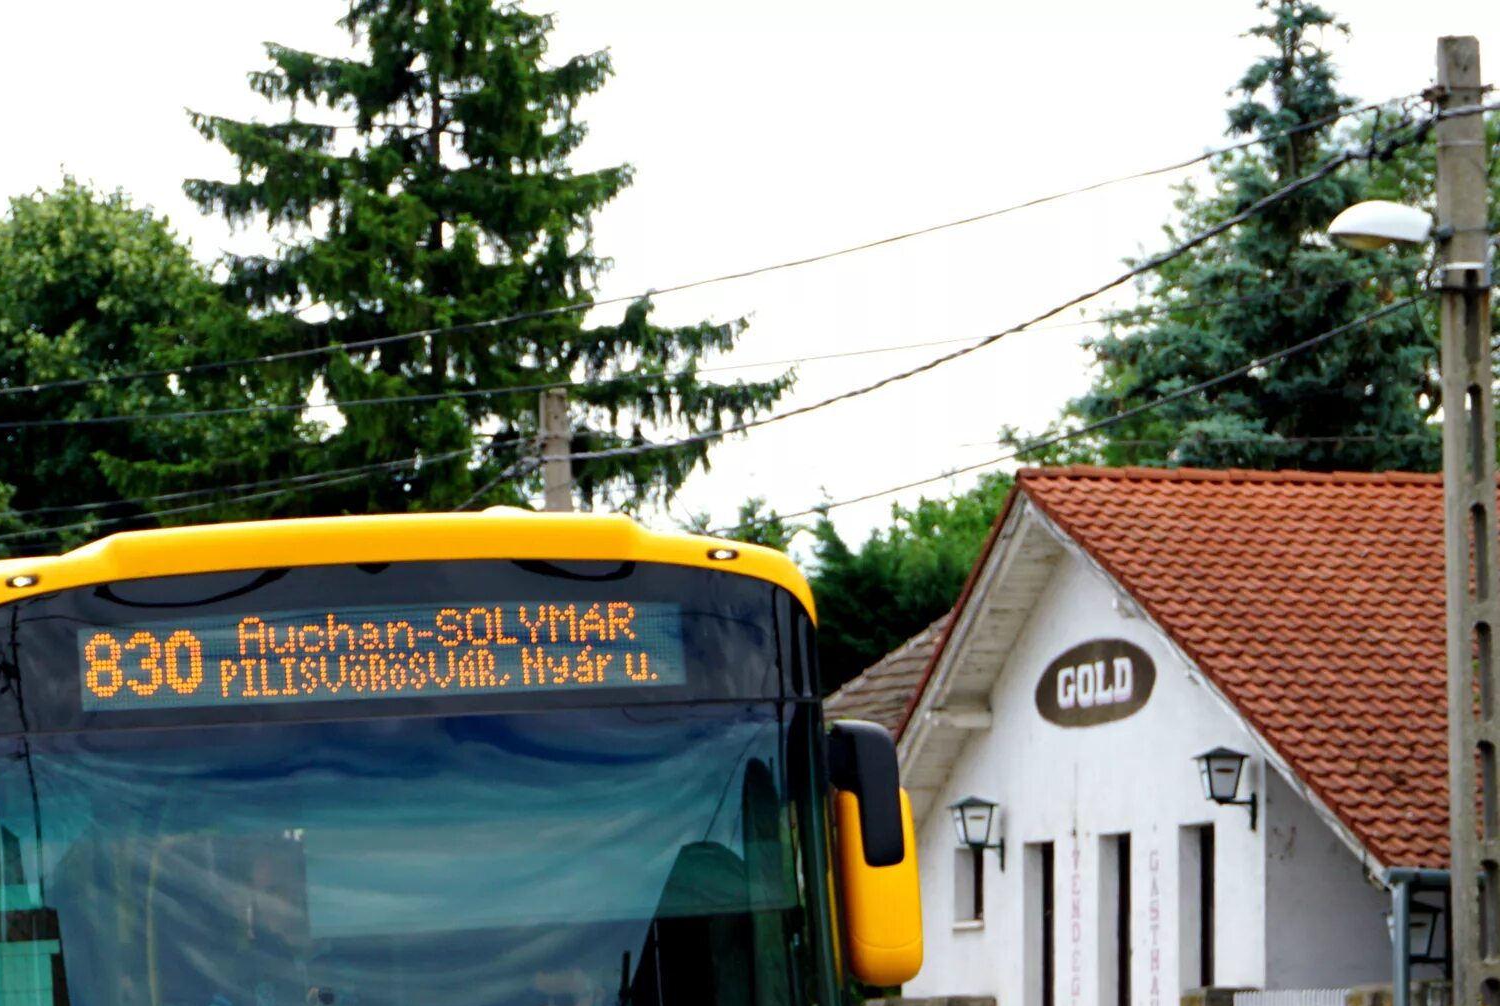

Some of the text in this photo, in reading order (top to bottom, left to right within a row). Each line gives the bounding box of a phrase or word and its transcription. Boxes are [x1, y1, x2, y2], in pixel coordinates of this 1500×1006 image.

[237, 601, 636, 656] Auchan-SOLYMÁR
[84, 629, 203, 698] 830
[520, 643, 613, 686] Nyár
[624, 651, 660, 682] u.
[1056, 656, 1134, 709] GOLD
